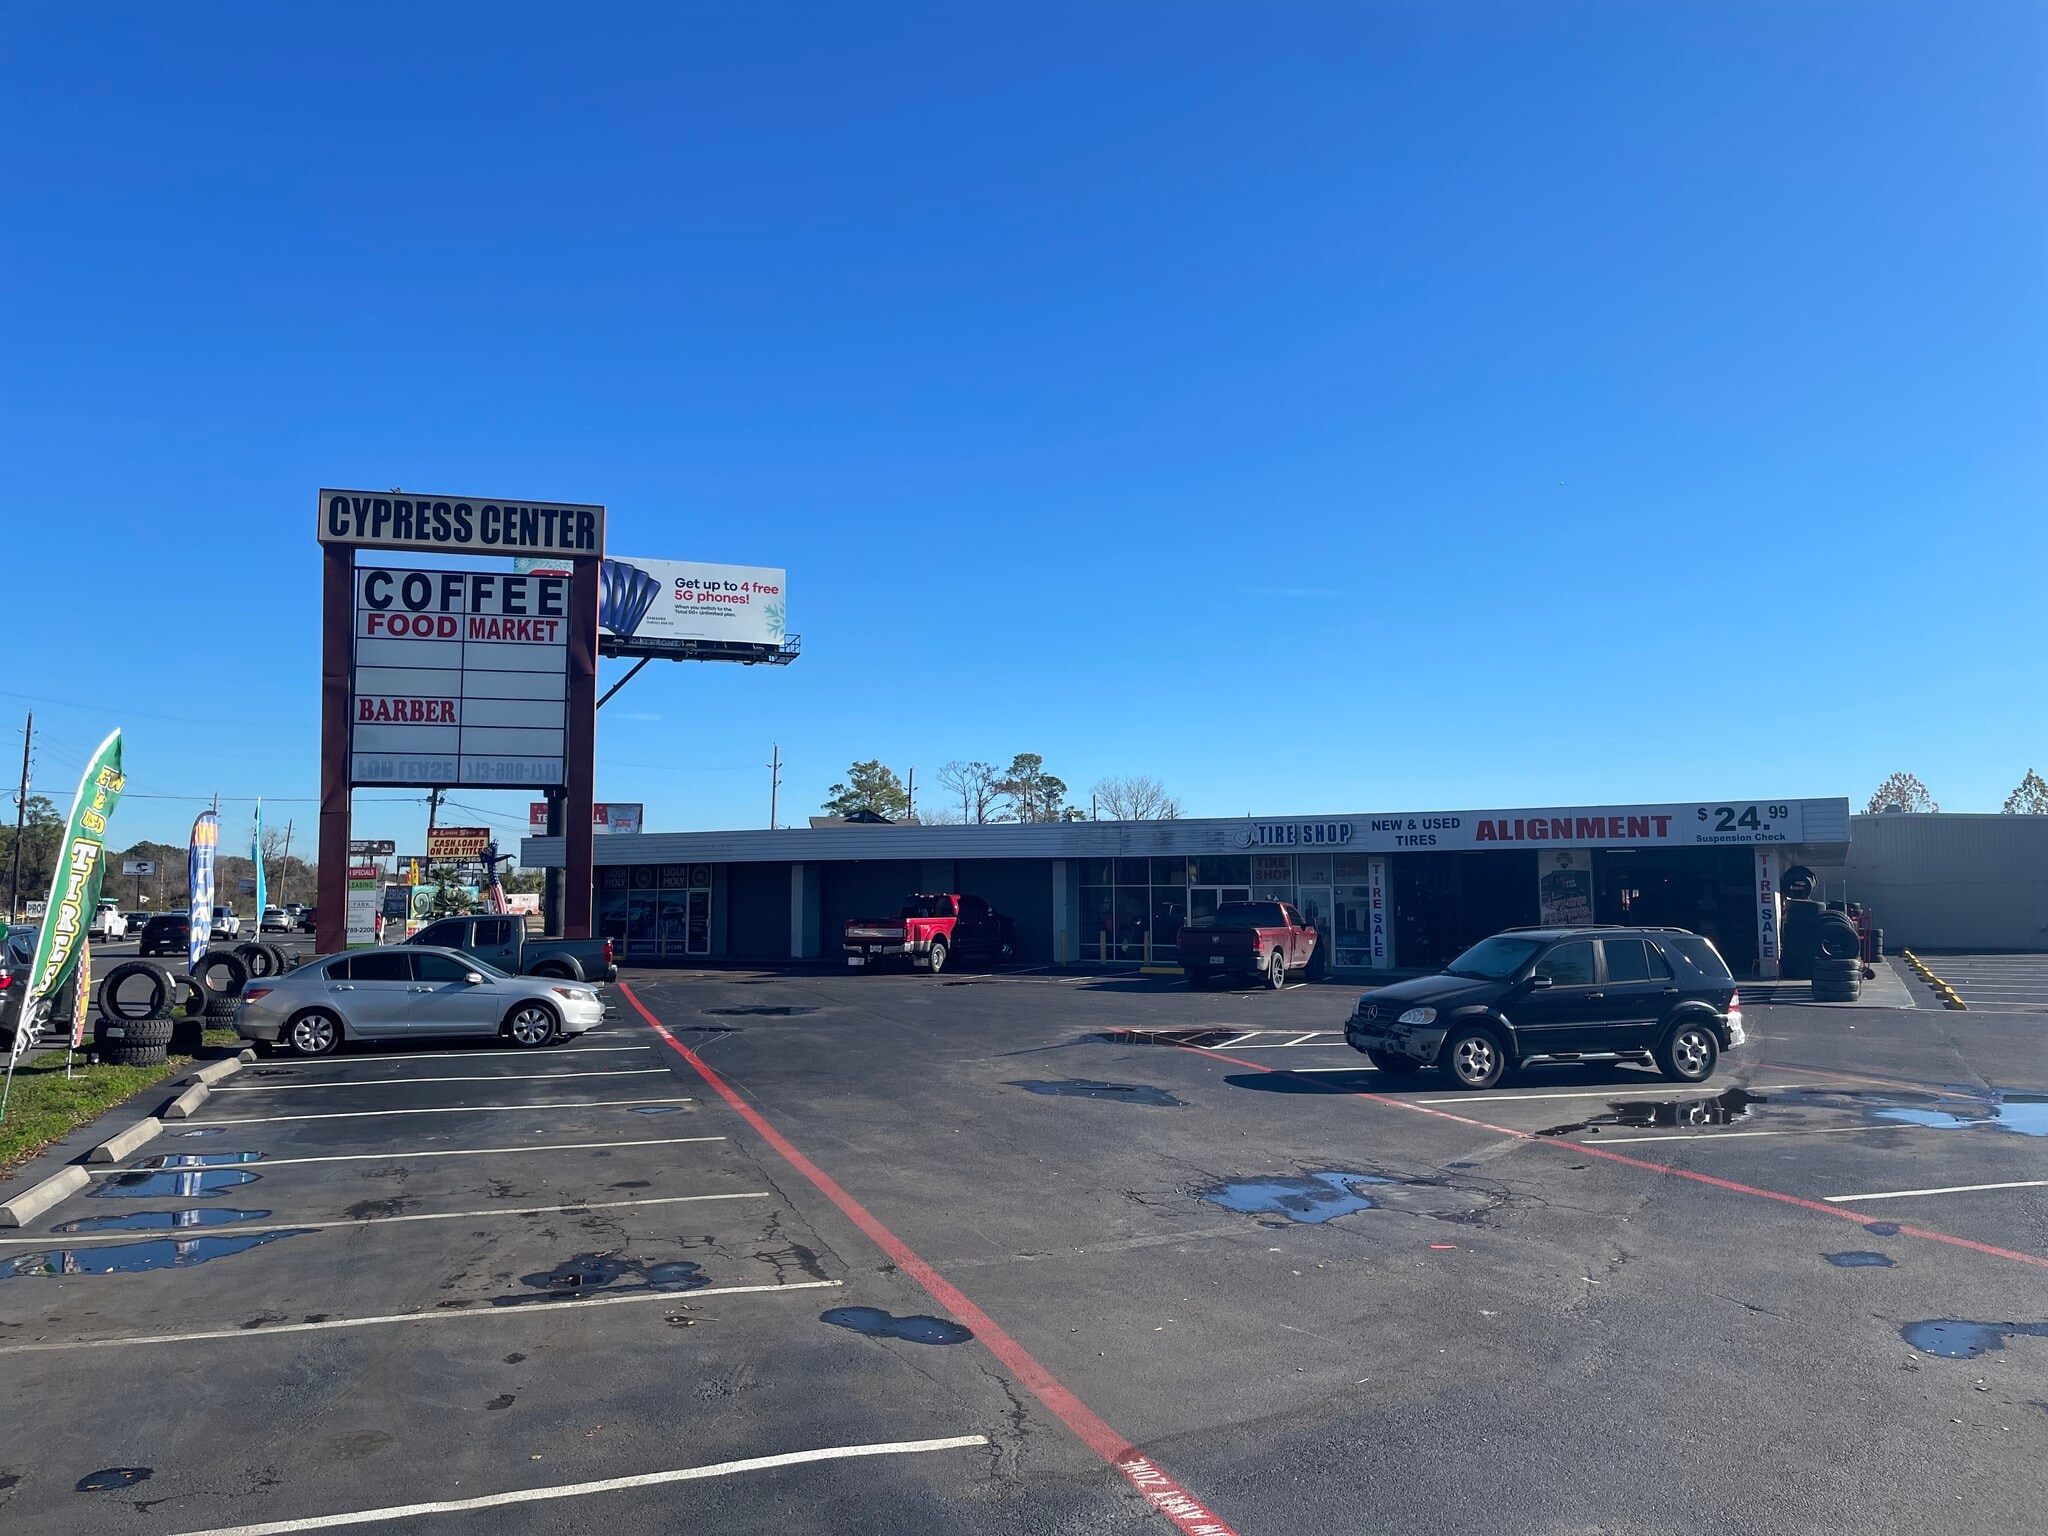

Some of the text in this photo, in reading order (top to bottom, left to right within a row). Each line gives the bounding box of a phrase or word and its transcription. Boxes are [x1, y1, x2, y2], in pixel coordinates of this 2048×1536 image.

[328, 496, 595, 550] CYPRESS CENTER
[364, 570, 563, 616] COFFEE
[675, 577, 779, 594] Get up to 4 free
[675, 590, 750, 604] 5G phones!
[367, 613, 559, 642] FOOD MARKET
[358, 698, 456, 723] BARBER
[1697, 807, 1708, 822] $
[1371, 817, 1461, 831] NEW & USED
[1475, 815, 1673, 842] ALIGNMENT
[434, 839, 485, 847] CASH LOANS
[1258, 824, 1350, 844] TIRE SHOP
[1395, 834, 1437, 846] TIRES
[1696, 832, 1786, 844] Suspension Check
[663, 868, 685, 877] LIQUI
[663, 878, 685, 886] MOLY
[1372, 864, 1383, 957] TIRE SALE
[1759, 854, 1774, 958] TIRE SALE
[38, 839, 100, 994] TIRES
